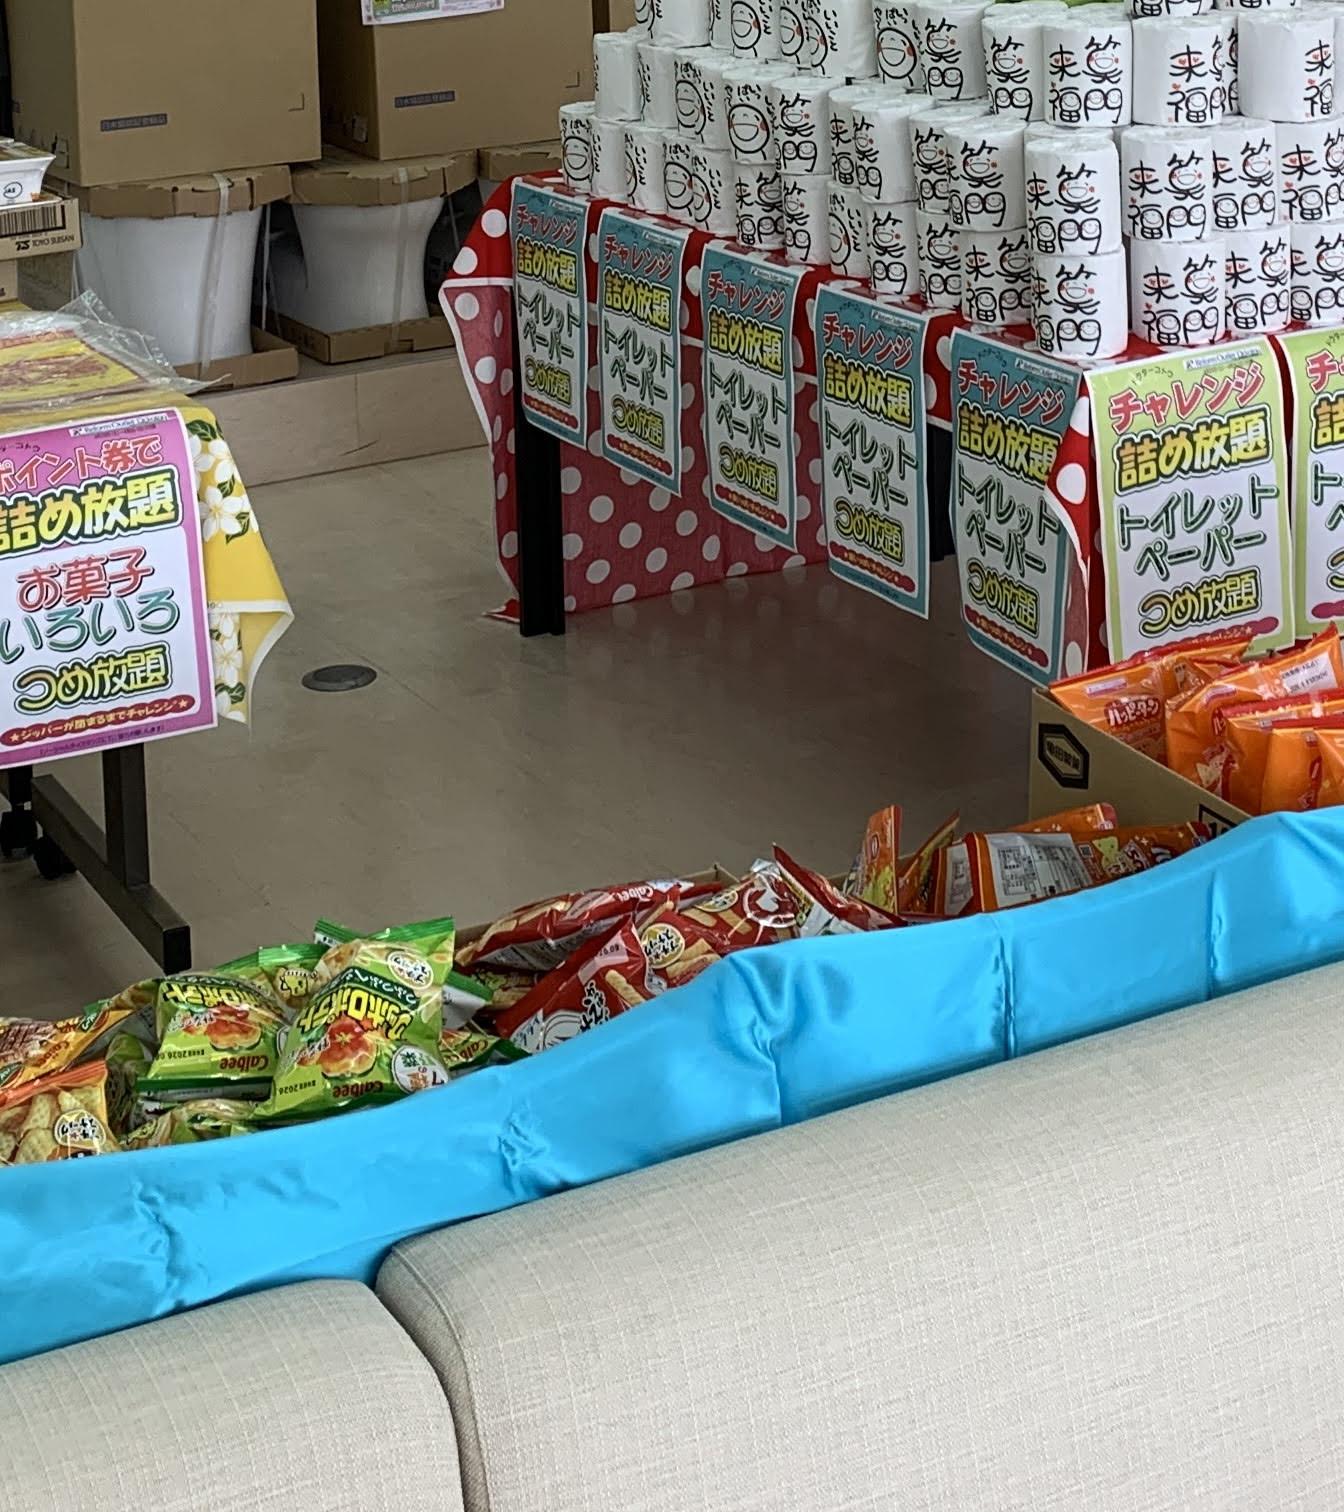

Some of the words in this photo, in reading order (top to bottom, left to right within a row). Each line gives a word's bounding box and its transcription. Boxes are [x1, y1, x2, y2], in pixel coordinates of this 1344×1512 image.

[824, 352, 914, 428] 詰め放題
[1109, 361, 1266, 434] チャレンジ
[1117, 410, 1270, 490] 詰め放題
[1118, 474, 1279, 551] トイレット
[1134, 523, 1267, 580] ペーパー
[219, 1055, 269, 1070] Calbee
